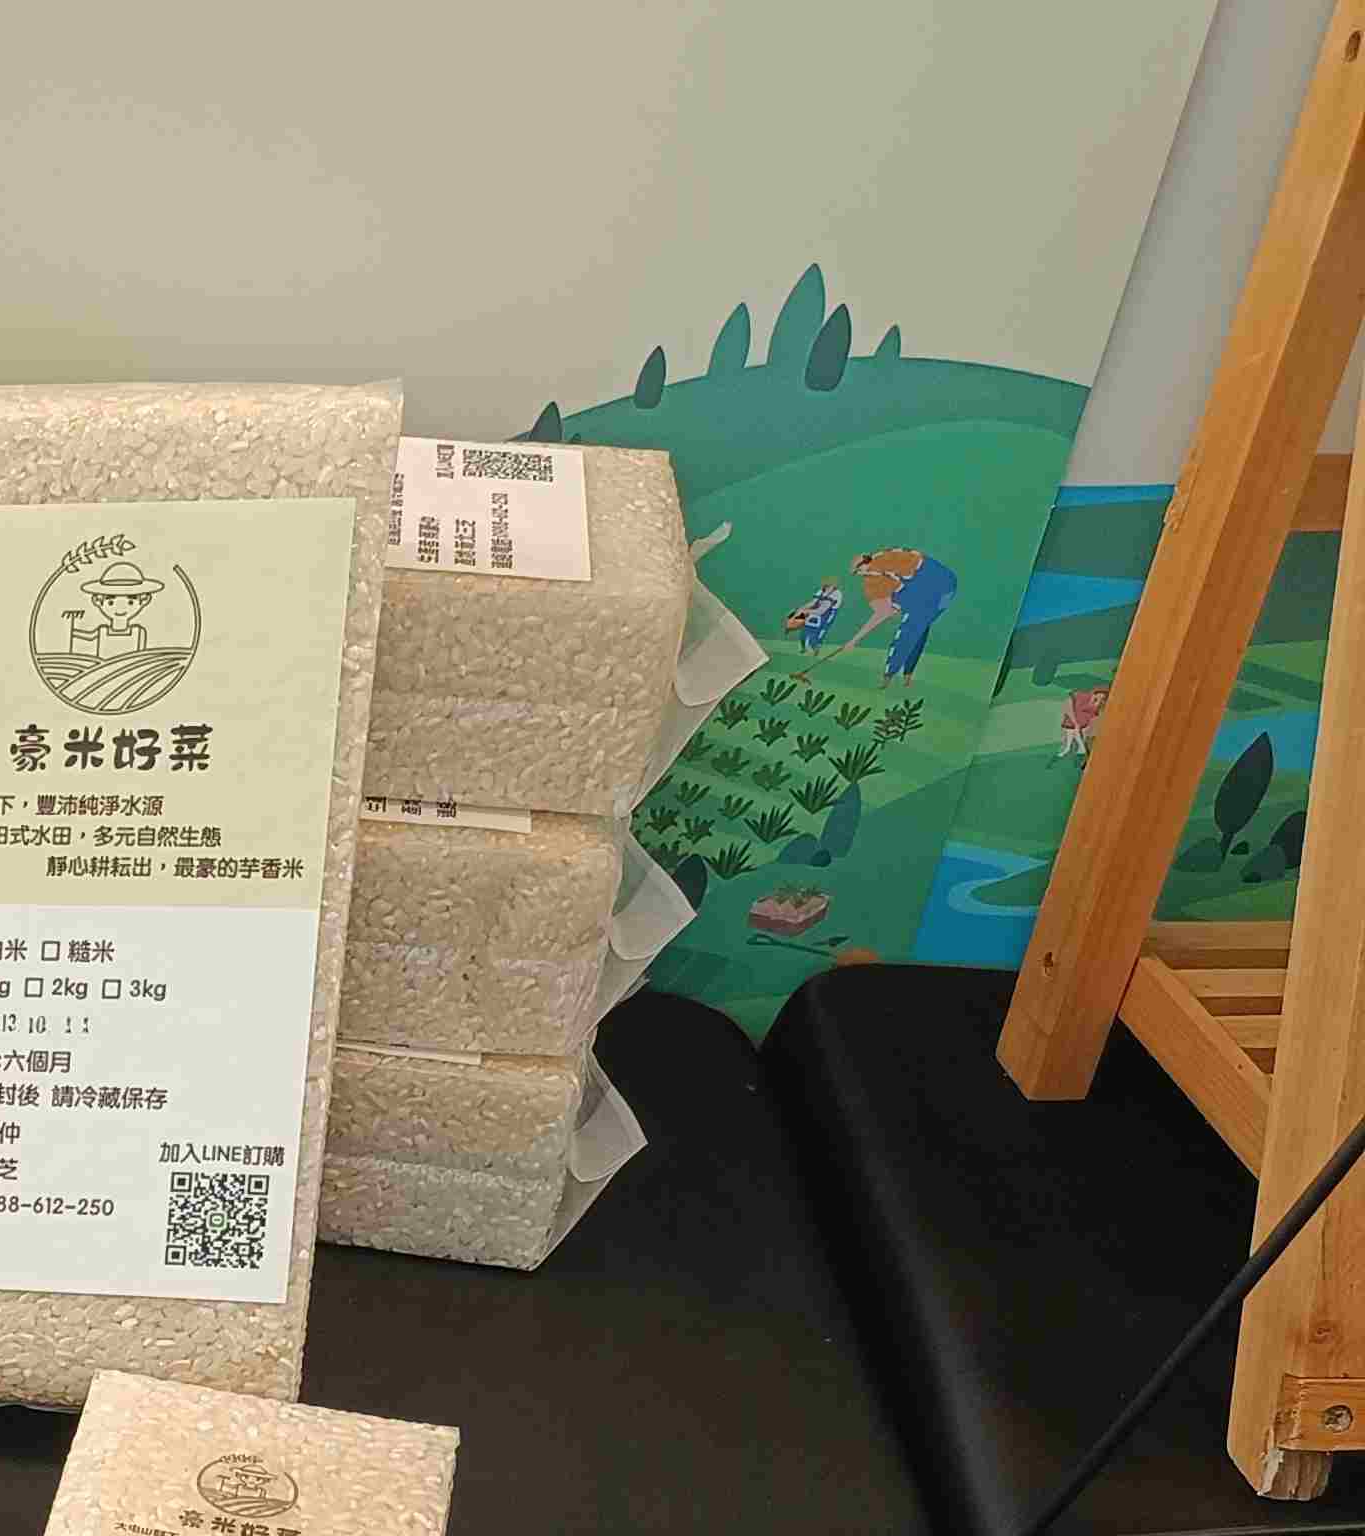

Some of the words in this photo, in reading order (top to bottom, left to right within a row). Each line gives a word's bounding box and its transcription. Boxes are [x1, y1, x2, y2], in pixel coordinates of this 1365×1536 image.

[9, 723, 214, 772] 豪米好菜
[68, 940, 114, 964] 糙米
[52, 979, 88, 1000] 2kg
[129, 979, 166, 1001] 3kg
[51, 1085, 168, 1110] 請冷藏保存
[159, 1142, 286, 1167] 加入LINE訂購
